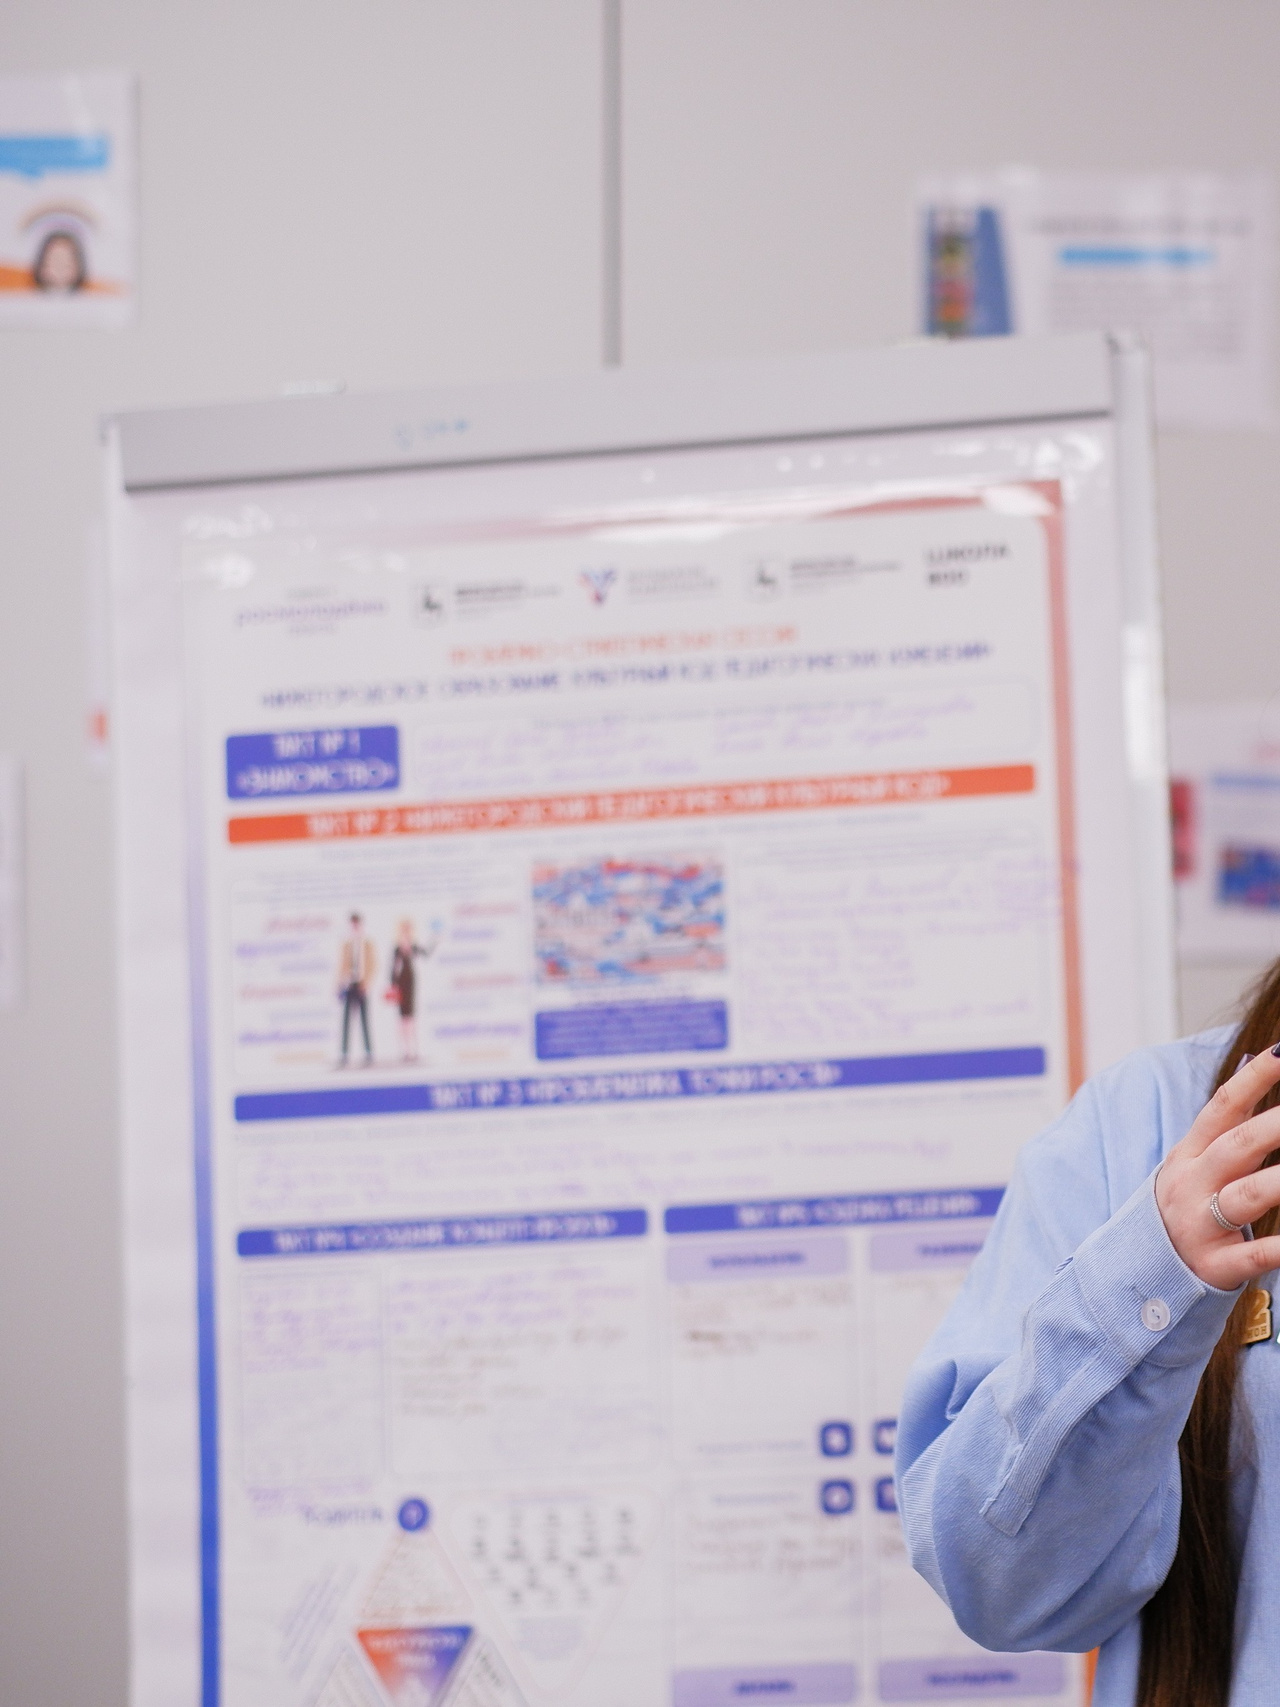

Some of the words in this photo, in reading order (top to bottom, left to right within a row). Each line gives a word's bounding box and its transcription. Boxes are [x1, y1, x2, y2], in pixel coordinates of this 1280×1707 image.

[274, 729, 315, 759] ТАКТ
[321, 727, 344, 756] №
[350, 726, 360, 755] 1
[237, 759, 393, 795] «ЗНАКОМСТВО»
[309, 812, 350, 837] ТАКТ
[431, 1084, 475, 1108] ТАКТ
